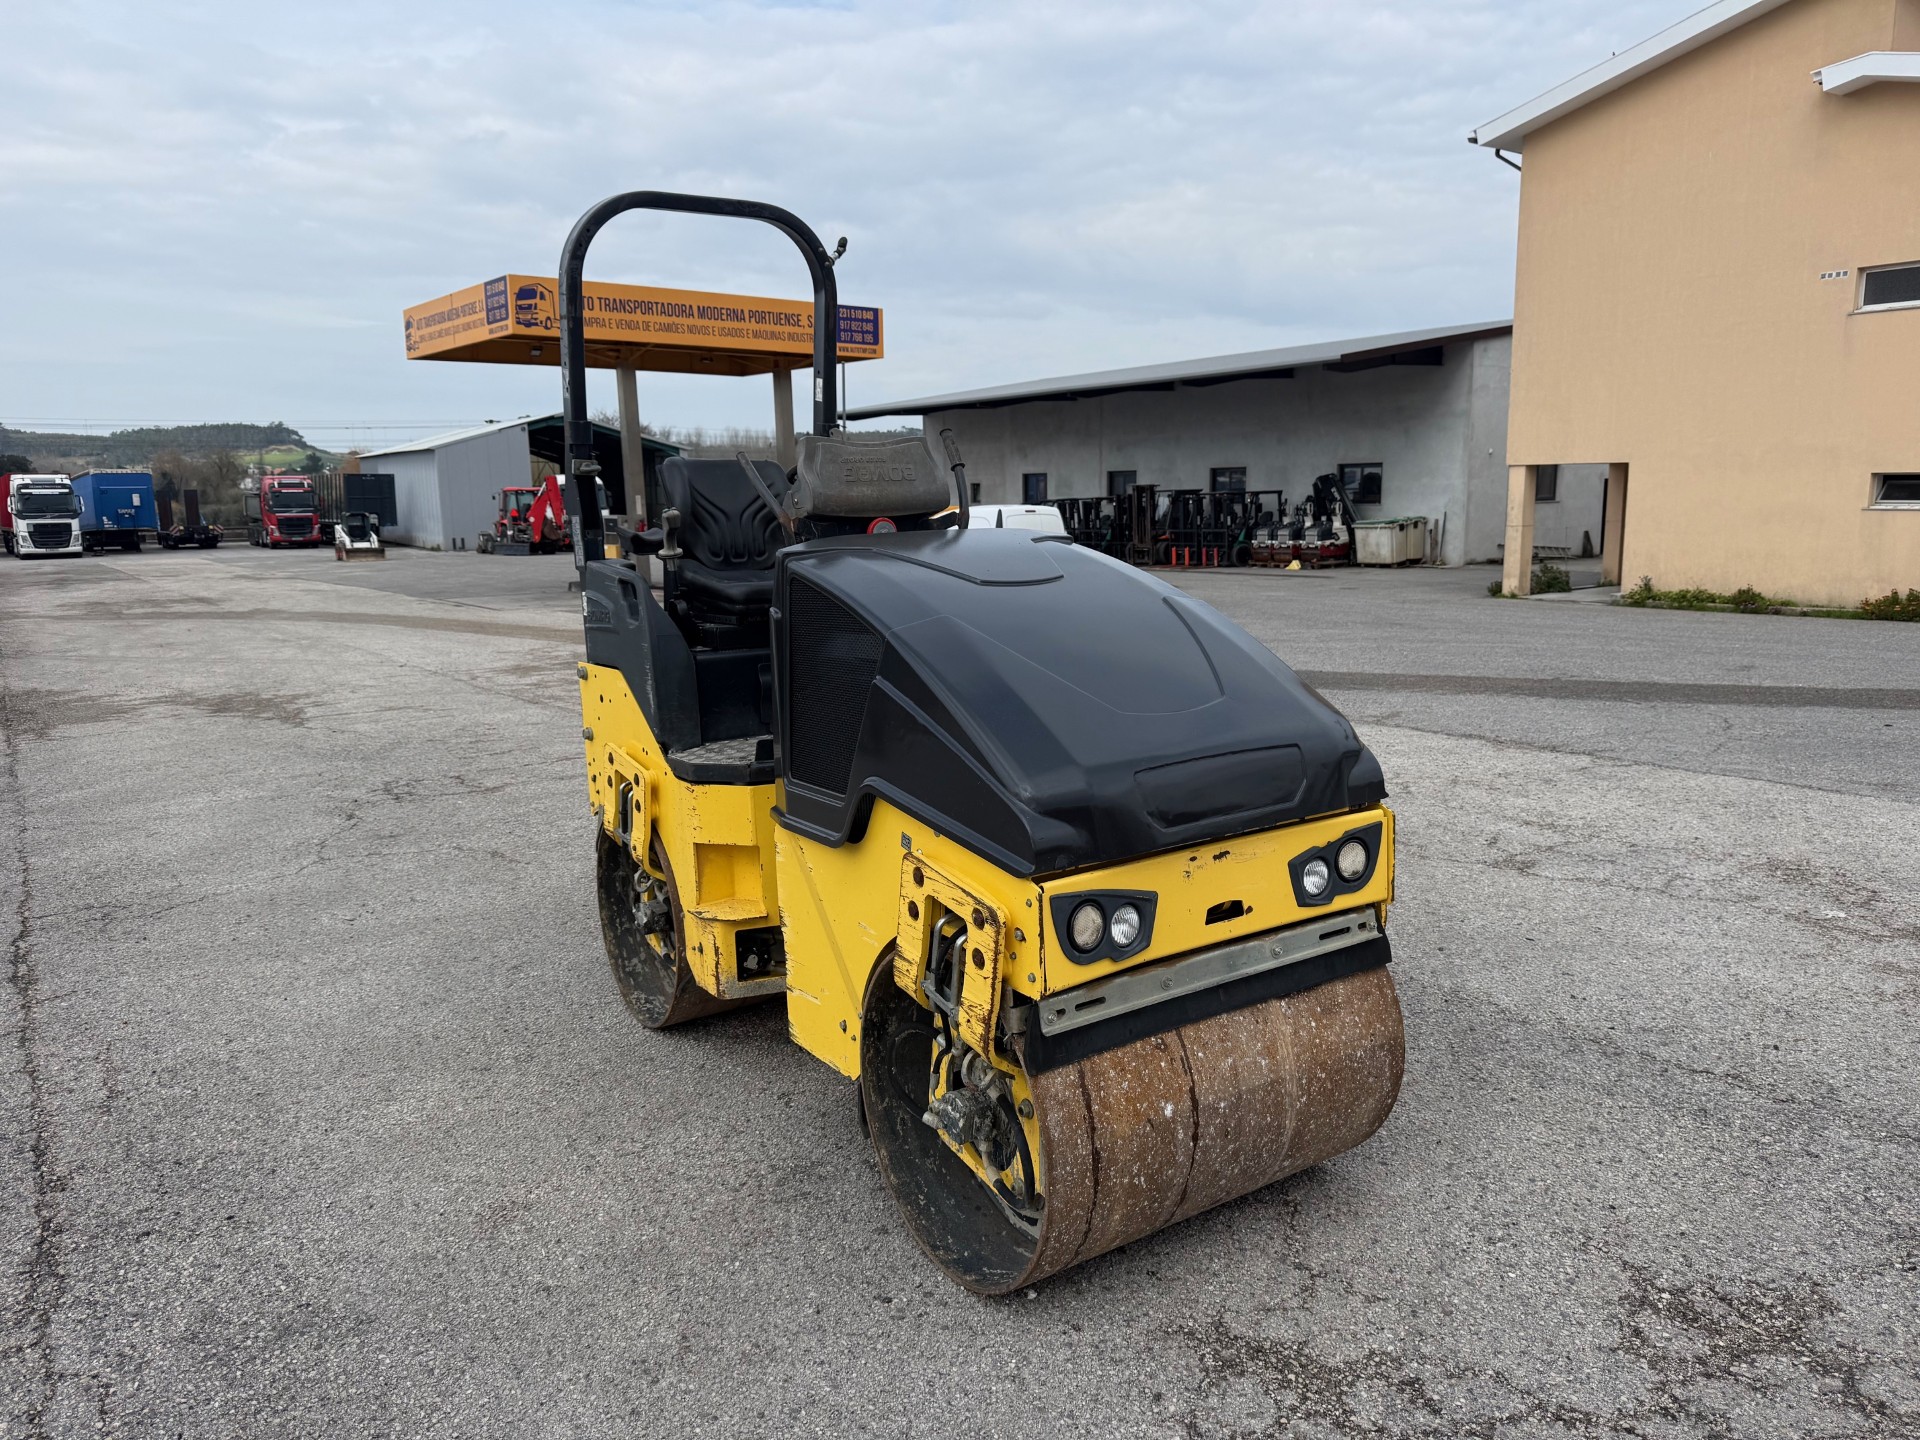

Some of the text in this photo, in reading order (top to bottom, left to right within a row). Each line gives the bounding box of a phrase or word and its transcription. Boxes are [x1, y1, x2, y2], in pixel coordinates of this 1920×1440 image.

[582, 296, 594, 311] TO
[596, 296, 694, 319] TRANSPORTADORA
[697, 305, 746, 324] MODERNA
[748, 311, 805, 329] PORTUENSE,
[839, 308, 850, 318] 231
[839, 320, 851, 329] 917
[584, 317, 606, 329] MPRA
[608, 318, 613, 329] E
[615, 319, 641, 331] VENDA
[642, 320, 652, 332] DE
[653, 321, 686, 334] CAMIÕES
[687, 324, 711, 336] NOVOS
[712, 326, 717, 336] E
[717, 326, 745, 339] USADOS
[746, 328, 751, 338] E
[787, 333, 814, 343] INDUSTR
[840, 332, 851, 341] 917
